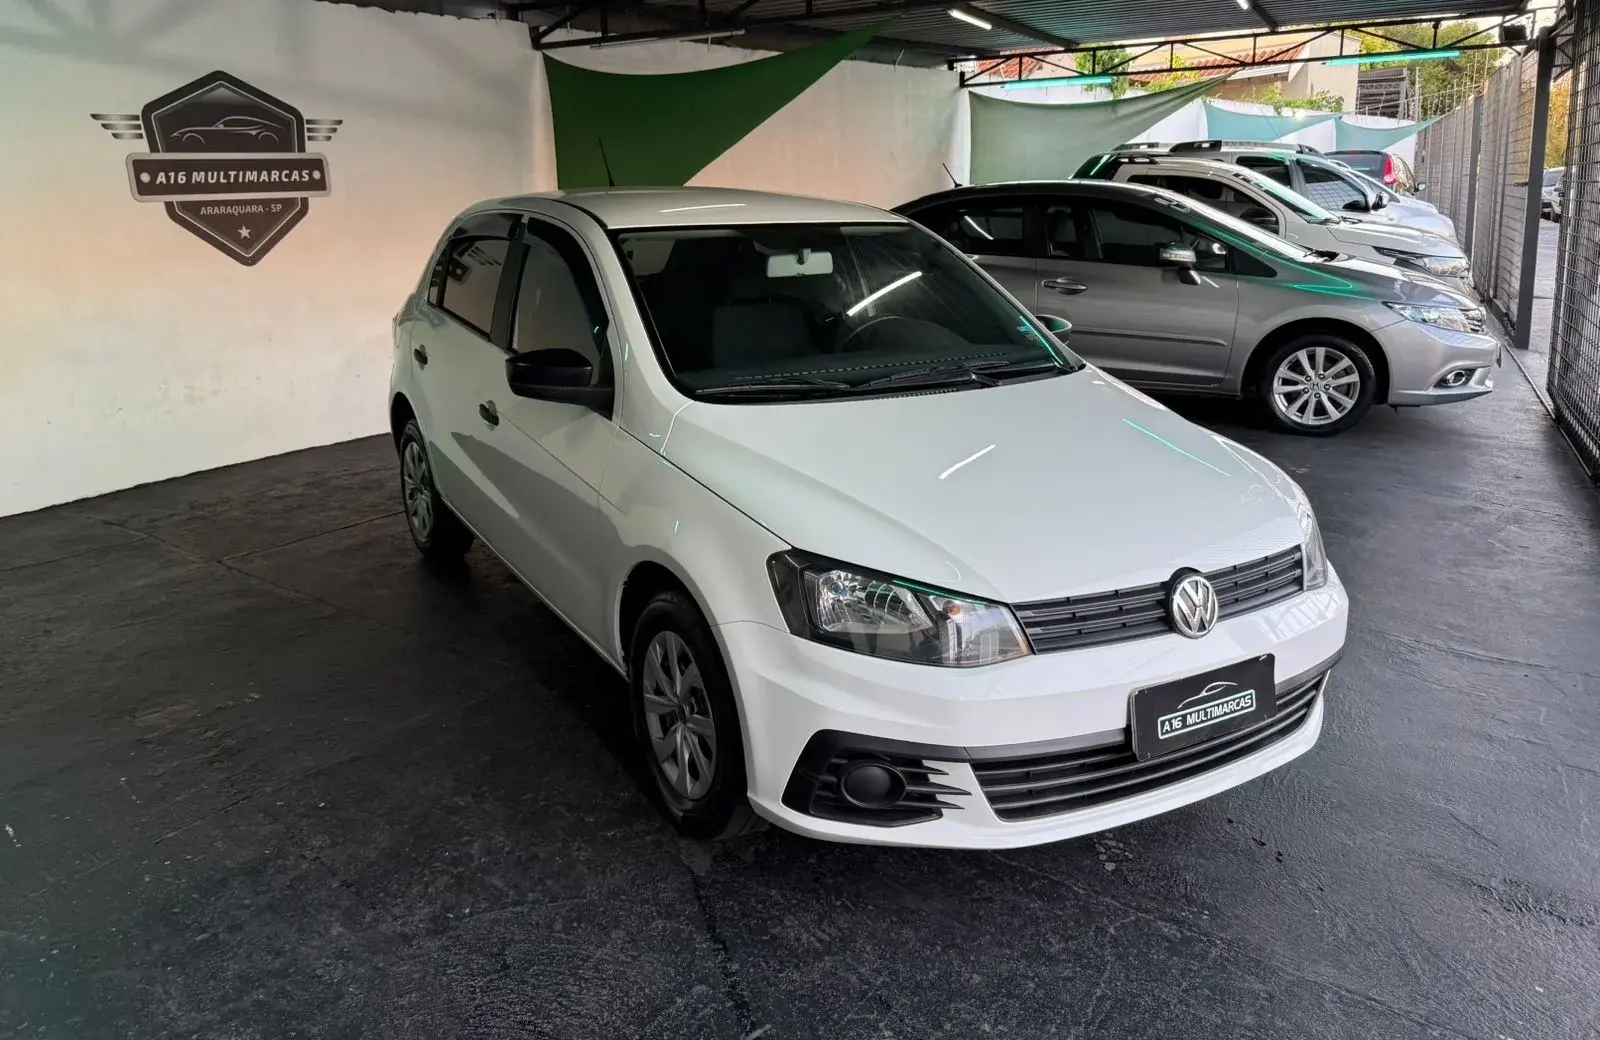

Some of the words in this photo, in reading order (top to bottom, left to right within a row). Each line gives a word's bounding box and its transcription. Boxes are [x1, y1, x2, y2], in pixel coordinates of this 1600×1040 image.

[156, 171, 187, 184] A16
[191, 170, 310, 184] MULTIMARCAS
[200, 205, 264, 216] ARARAQUARA
[271, 203, 283, 213] SP
[1162, 718, 1183, 733] A16
[1186, 695, 1252, 726] MULTIMARCAS
